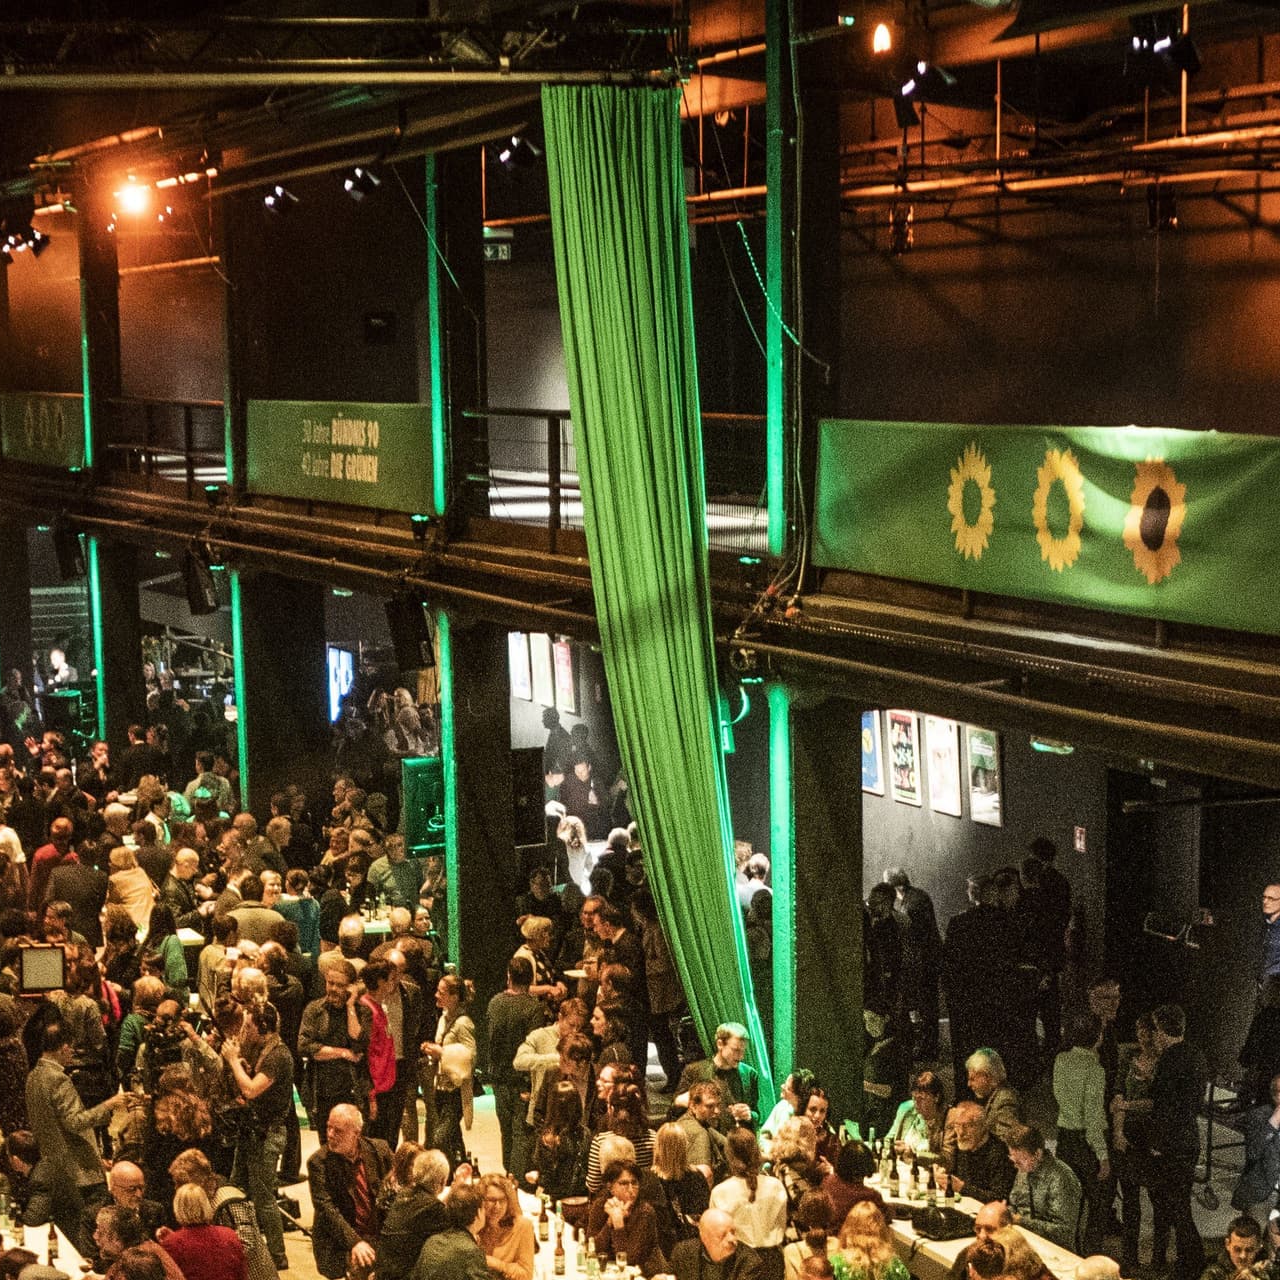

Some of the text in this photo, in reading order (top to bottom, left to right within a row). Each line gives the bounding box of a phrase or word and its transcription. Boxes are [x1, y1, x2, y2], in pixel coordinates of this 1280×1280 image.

[331, 412, 366, 447] BÜNDNIS
[367, 420, 380, 449] 90
[345, 448, 378, 483] GRÜNEN
